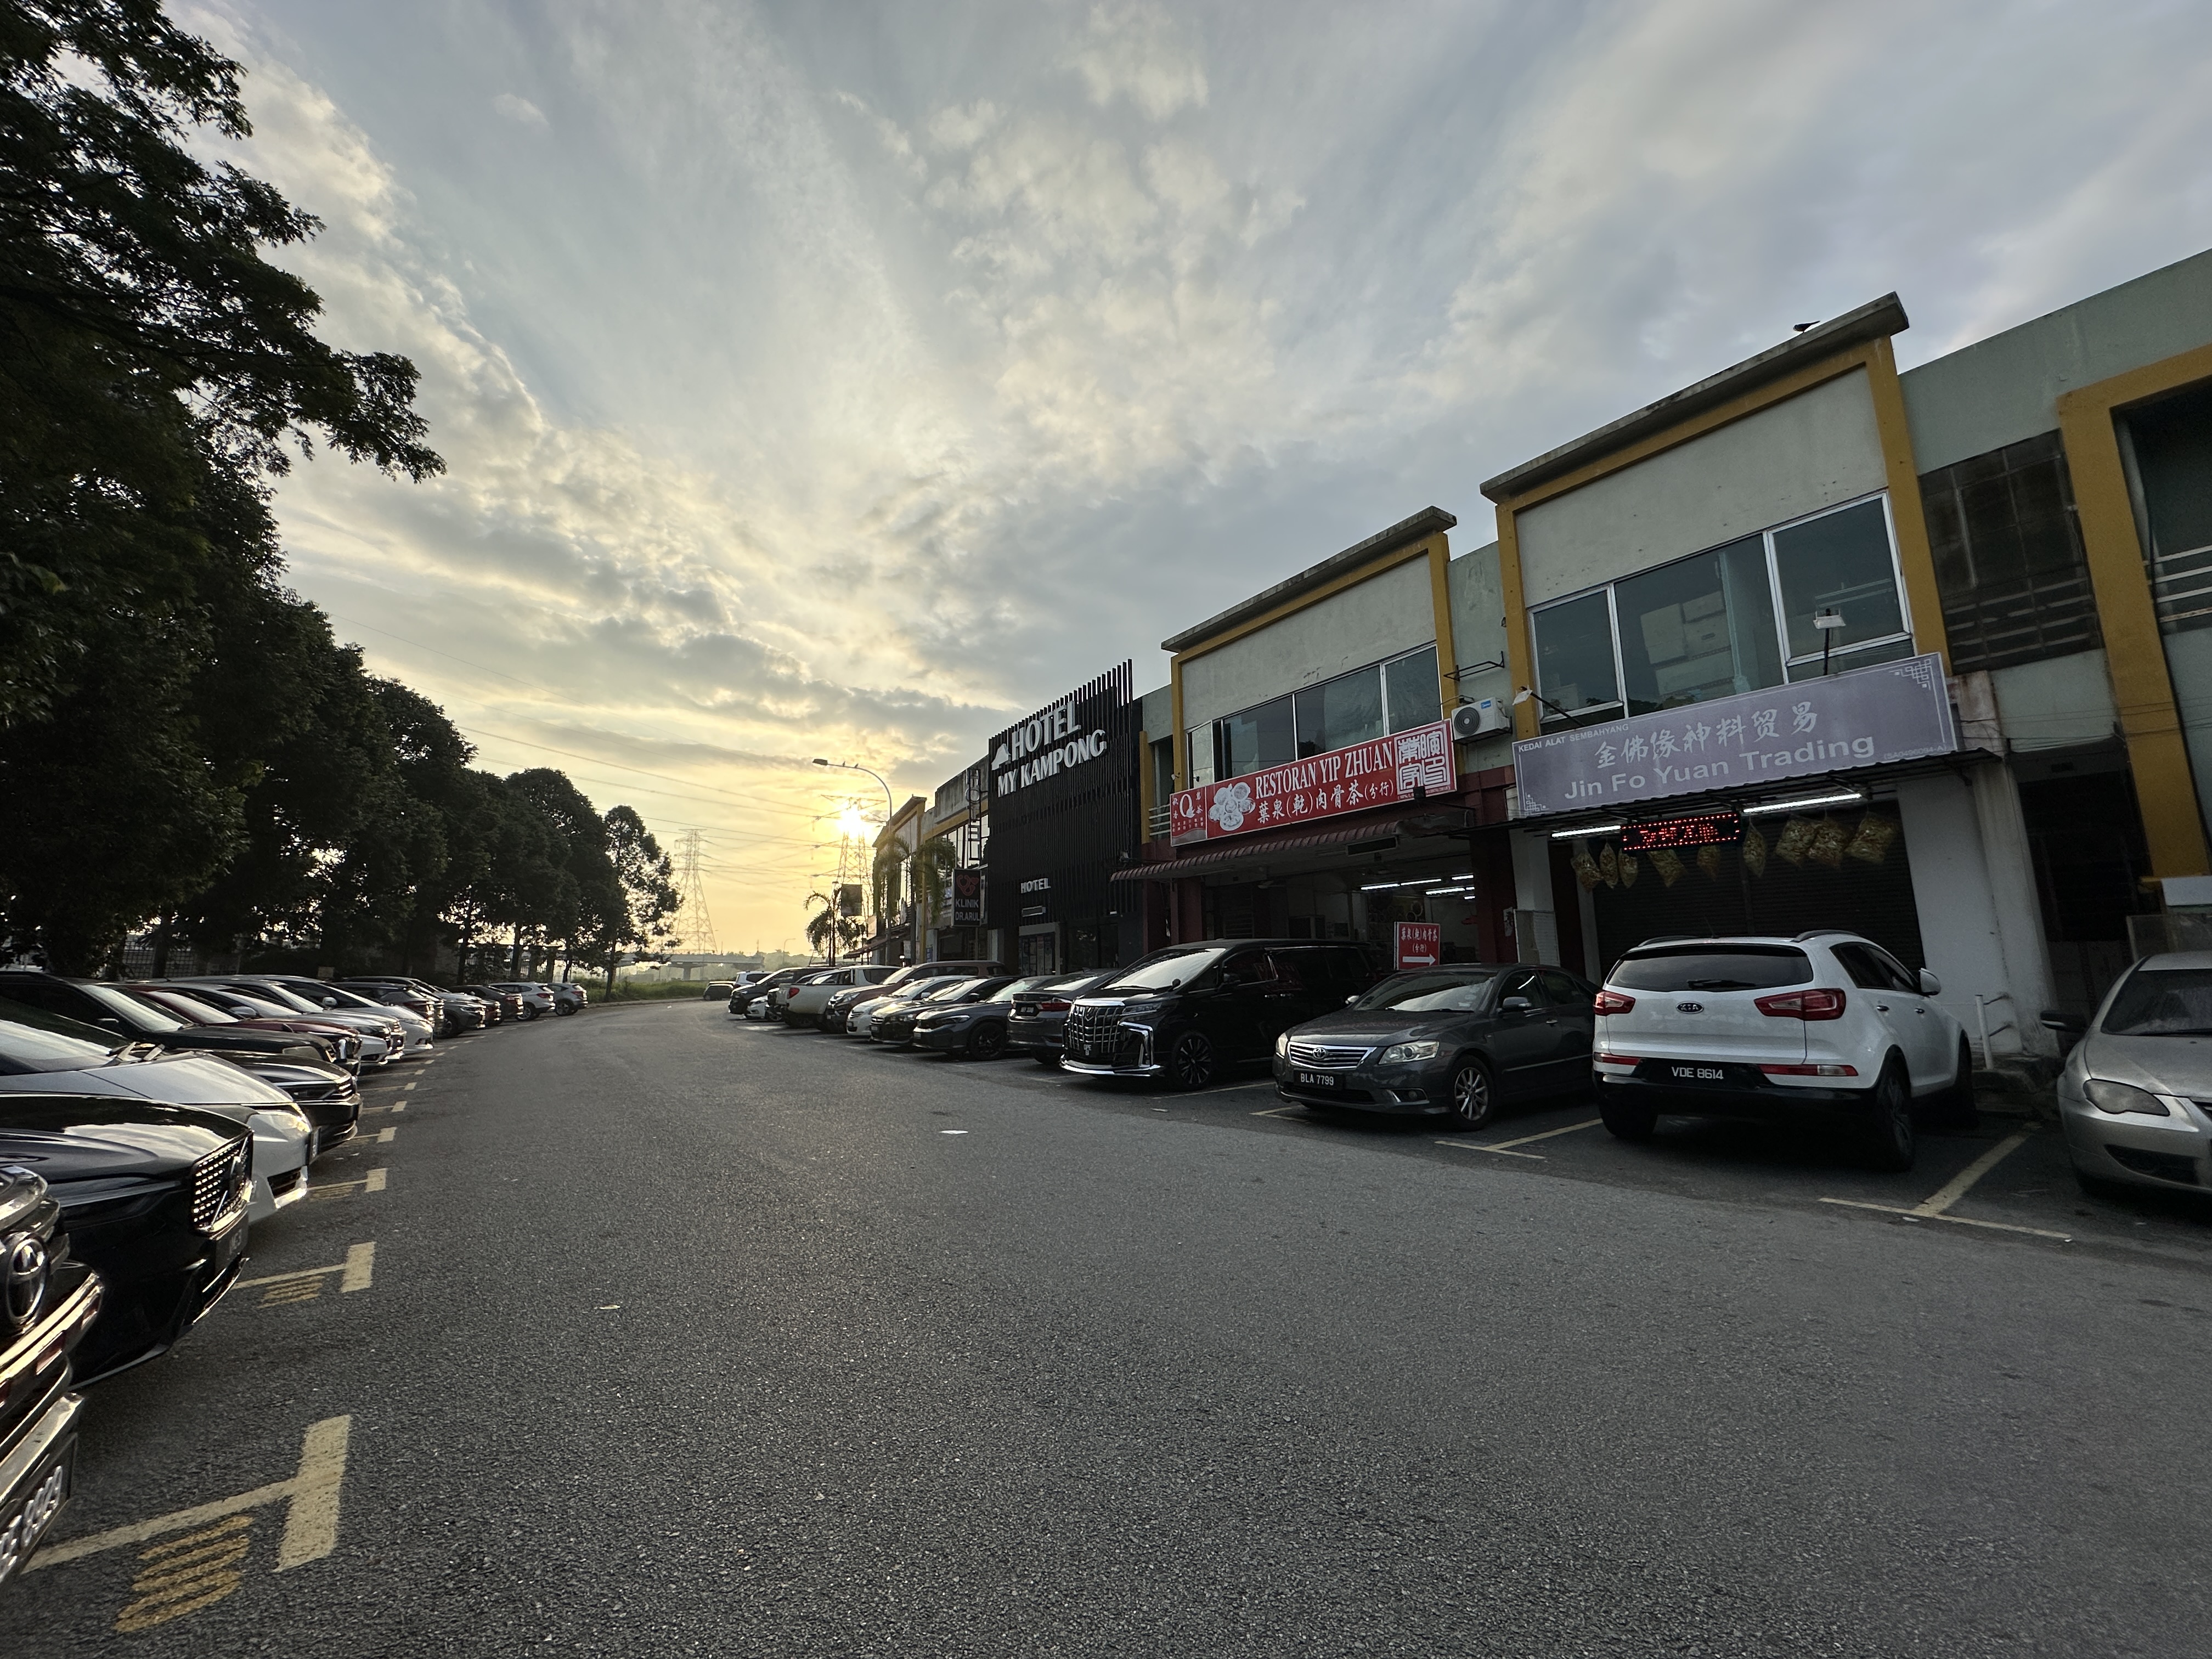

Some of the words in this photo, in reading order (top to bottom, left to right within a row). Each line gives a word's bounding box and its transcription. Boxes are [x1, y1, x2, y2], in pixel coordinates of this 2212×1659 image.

[1012, 701, 1081, 761] HOTEL
[1518, 741, 1542, 752] KEDAI
[1545, 736, 1565, 747] ALAT
[1570, 724, 1629, 741] SEMBAHYANG
[998, 769, 1018, 798] MY
[1021, 729, 1107, 788] KAMPONG
[1255, 761, 1316, 799] RESTORAN
[1319, 755, 1341, 784] YIP
[1345, 741, 1393, 778] ZHUAN
[1564, 781, 1602, 800] Jin
[1611, 773, 1646, 791] Fo
[1654, 759, 1729, 785] Yuan
[1740, 736, 1875, 770] Trading
[1021, 878, 1051, 894] HOTEL
[955, 899, 979, 909] KLINIK
[955, 911, 980, 921] DR.ARUL
[1679, 1003, 1699, 1012] KIA
[1300, 1073, 1314, 1083] BLA
[1317, 1075, 1334, 1086] 7799
[1671, 1066, 1694, 1077] VDE
[1697, 1068, 1724, 1080] 8614
